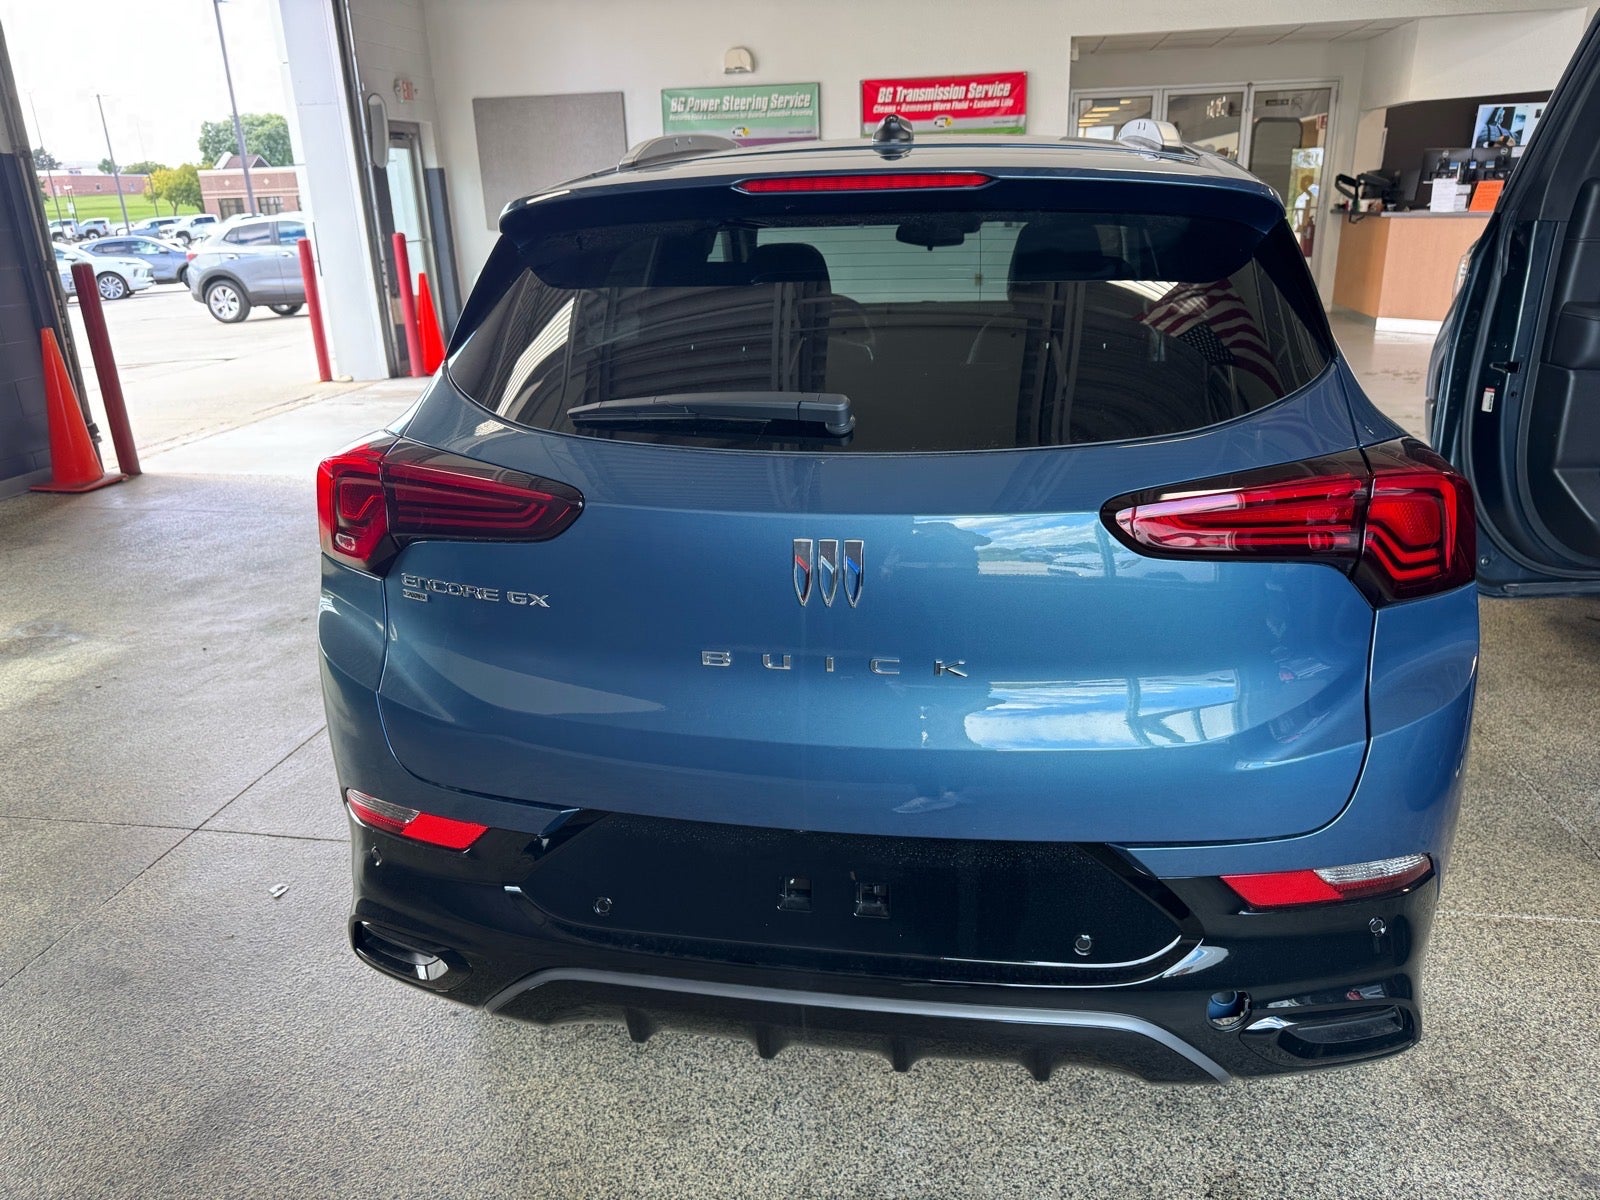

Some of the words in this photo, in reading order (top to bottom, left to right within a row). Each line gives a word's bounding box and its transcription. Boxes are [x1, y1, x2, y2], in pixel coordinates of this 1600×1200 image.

[671, 97, 685, 112] BG
[687, 97, 720, 112] Power
[723, 94, 768, 111] Steering
[771, 93, 811, 109] Service
[878, 87, 893, 103] BG
[896, 84, 966, 102] Transmission
[968, 81, 1011, 98] Service
[873, 104, 896, 114] Cleans
[901, 102, 931, 112] Removes
[933, 101, 951, 111] Worn
[952, 100, 969, 110] Fluid
[974, 98, 1000, 108] Extends
[1001, 97, 1014, 107] Life
[401, 572, 500, 602] ENCORE
[506, 591, 551, 608] GX
[701, 650, 968, 678] BUICK
